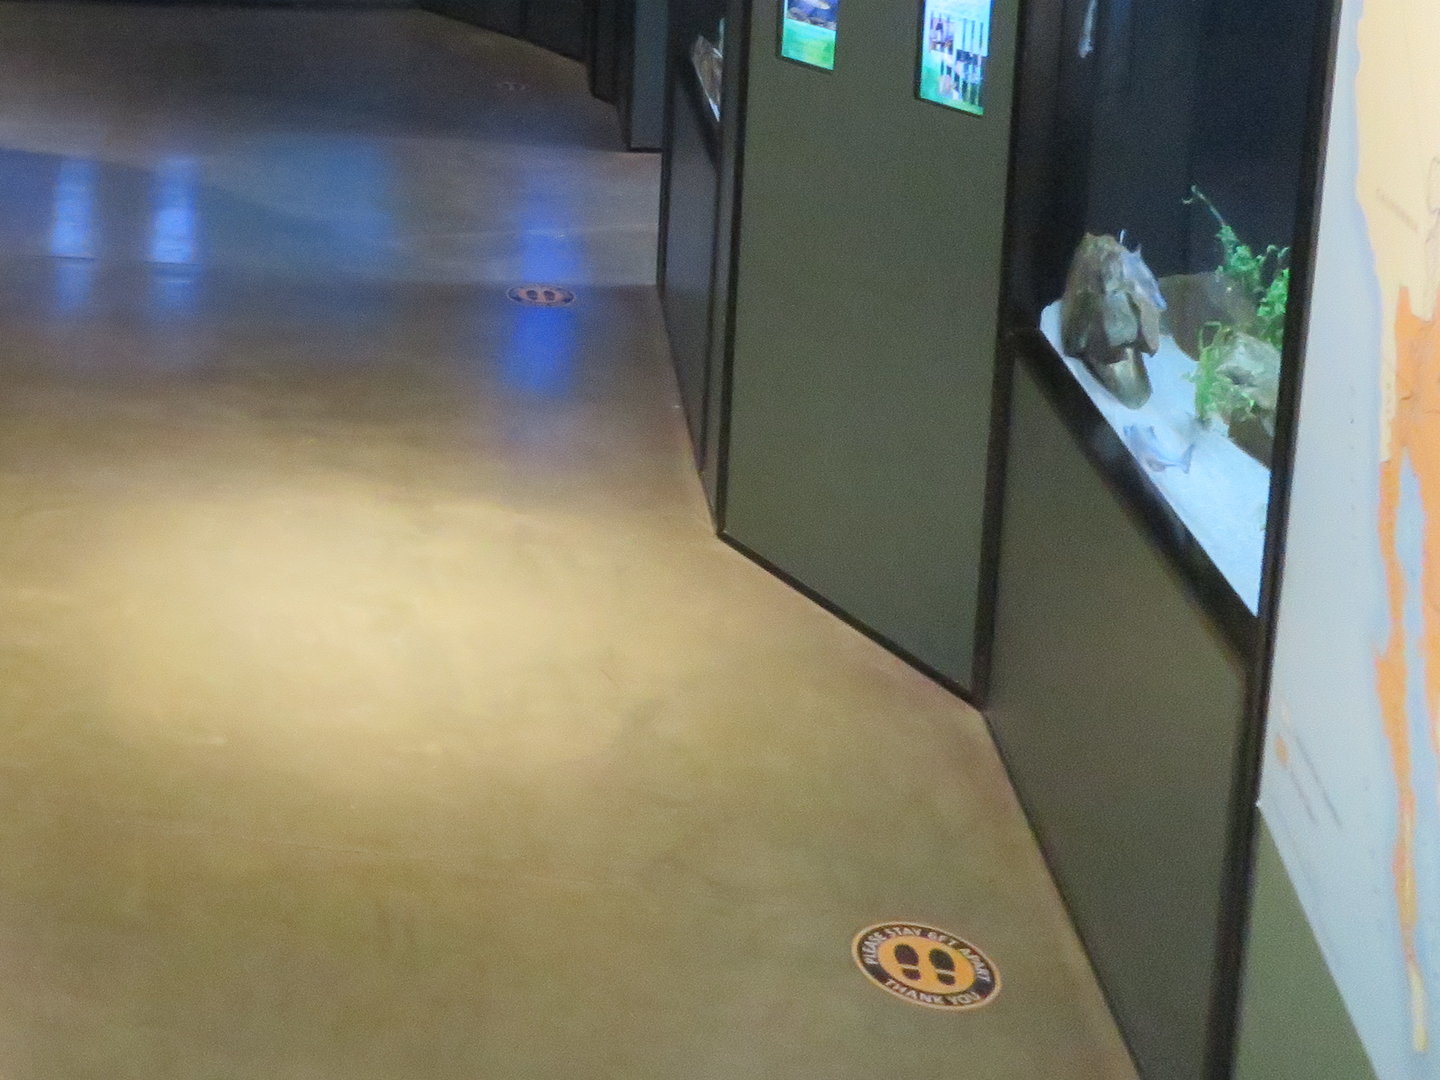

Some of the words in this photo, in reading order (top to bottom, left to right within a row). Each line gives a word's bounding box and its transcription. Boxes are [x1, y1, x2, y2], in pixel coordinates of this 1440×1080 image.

[862, 931, 886, 965] PLEASE
[884, 927, 922, 939] STAY
[885, 978, 944, 1004] THANK
[948, 991, 979, 1005] YOU
